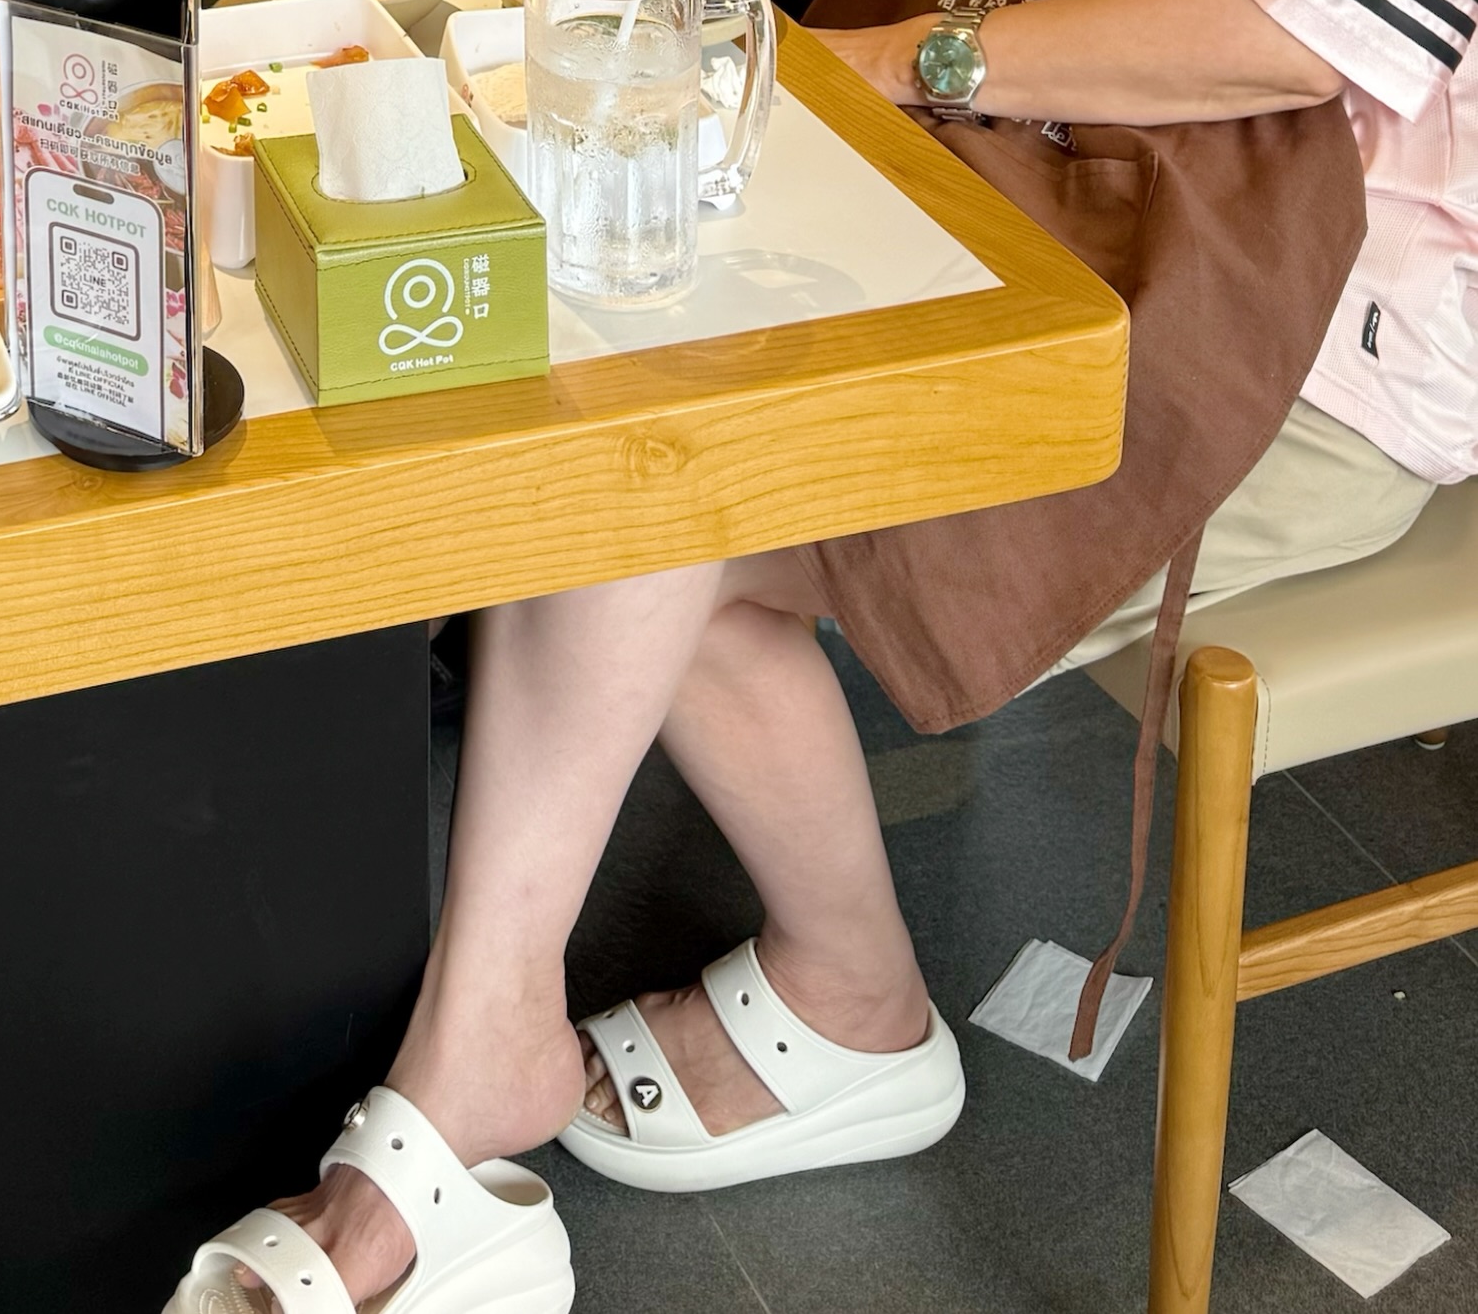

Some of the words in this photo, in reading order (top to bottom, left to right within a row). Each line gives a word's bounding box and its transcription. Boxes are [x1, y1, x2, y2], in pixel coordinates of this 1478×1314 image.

[102, 110, 120, 121] Pot
[46, 198, 80, 219] CQK
[85, 207, 147, 239] HOTPOT
[83, 273, 107, 288] LINE
[471, 253, 491, 320] 磁器口
[390, 359, 414, 372] CQK
[415, 356, 435, 369] Hot
[435, 354, 454, 366] Pot
[634, 1083, 660, 1107] A
